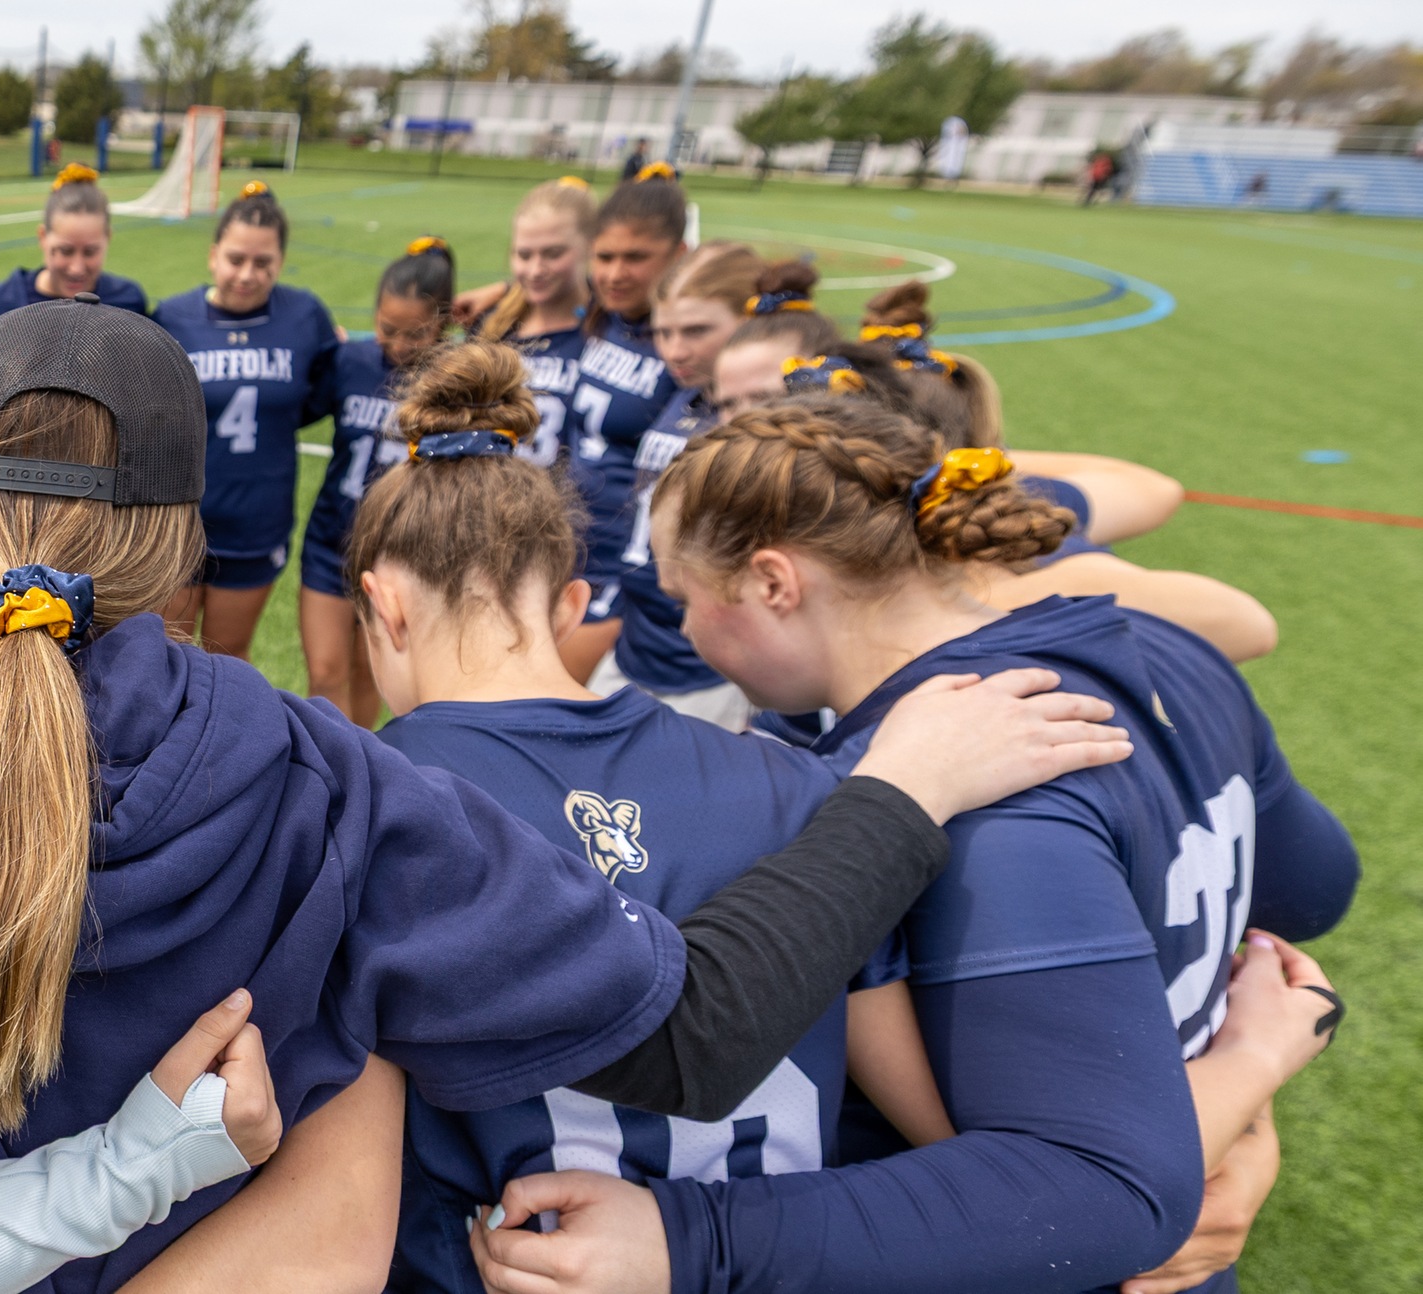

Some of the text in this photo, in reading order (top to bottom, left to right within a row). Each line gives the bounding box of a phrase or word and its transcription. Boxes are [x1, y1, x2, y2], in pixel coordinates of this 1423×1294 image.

[580, 335, 667, 399] UFFOLK
[216, 385, 258, 454] 4
[573, 383, 613, 461] 7
